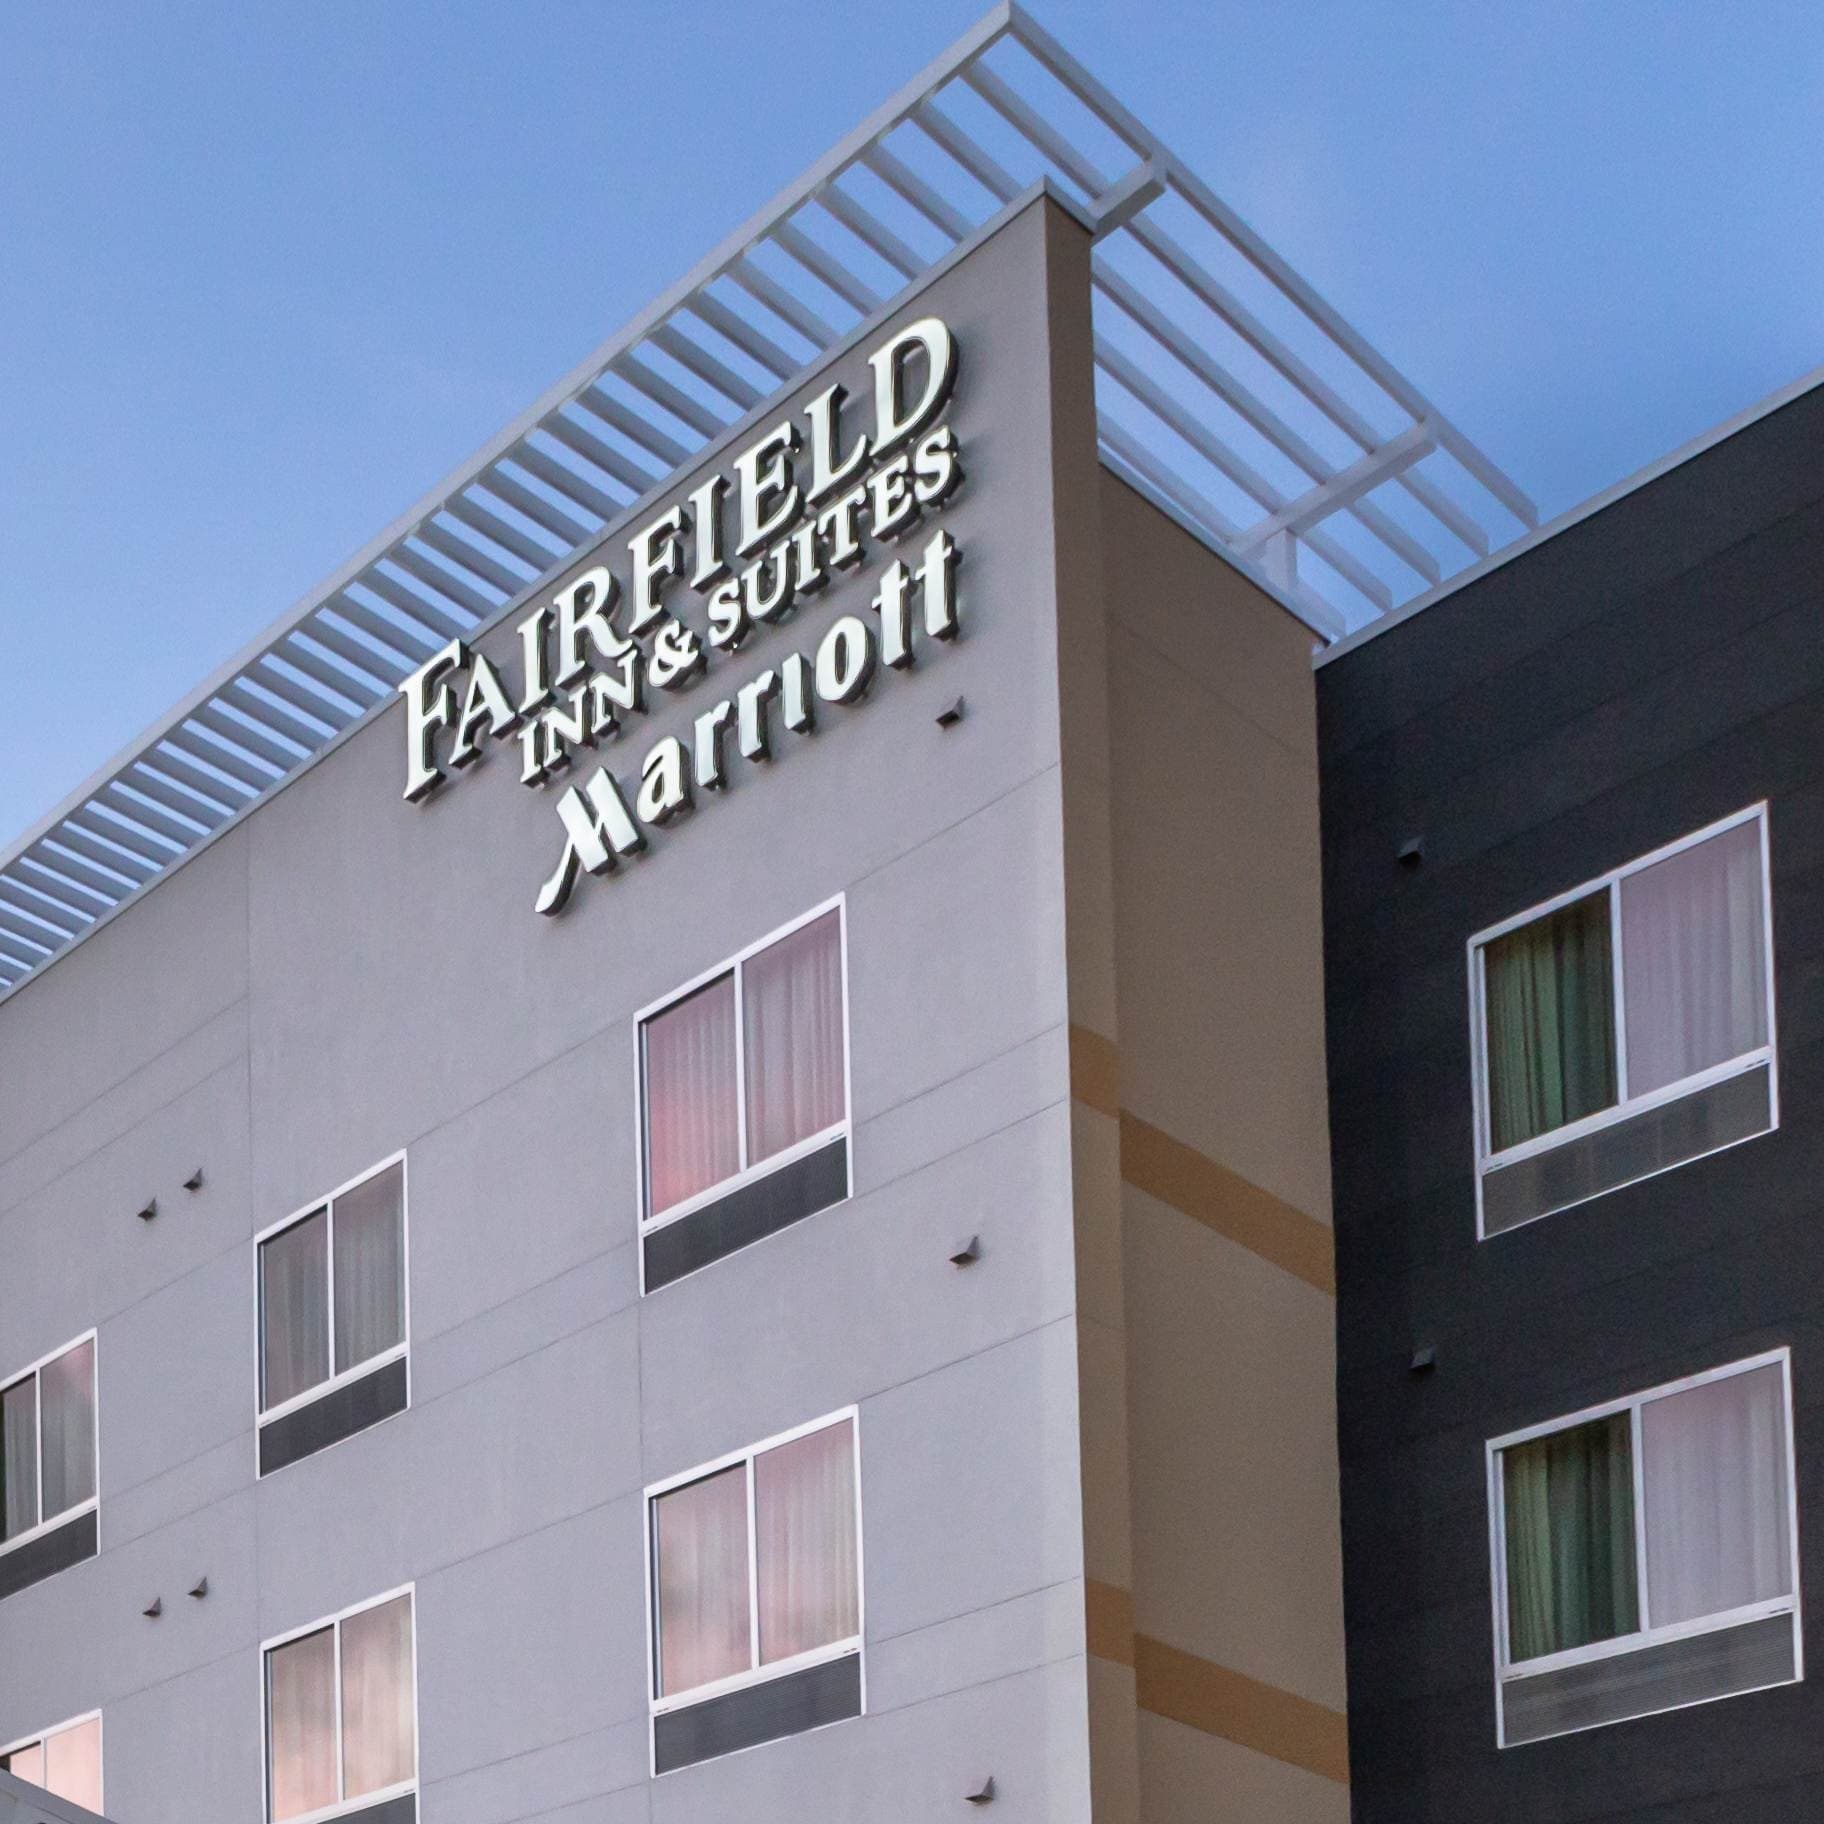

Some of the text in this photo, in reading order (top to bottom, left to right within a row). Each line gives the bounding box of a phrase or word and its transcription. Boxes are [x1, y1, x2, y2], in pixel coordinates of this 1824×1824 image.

[398, 318, 959, 803] FAIRFIELD
[520, 427, 964, 786] INN & SUITES
[535, 529, 961, 914] Marriott
